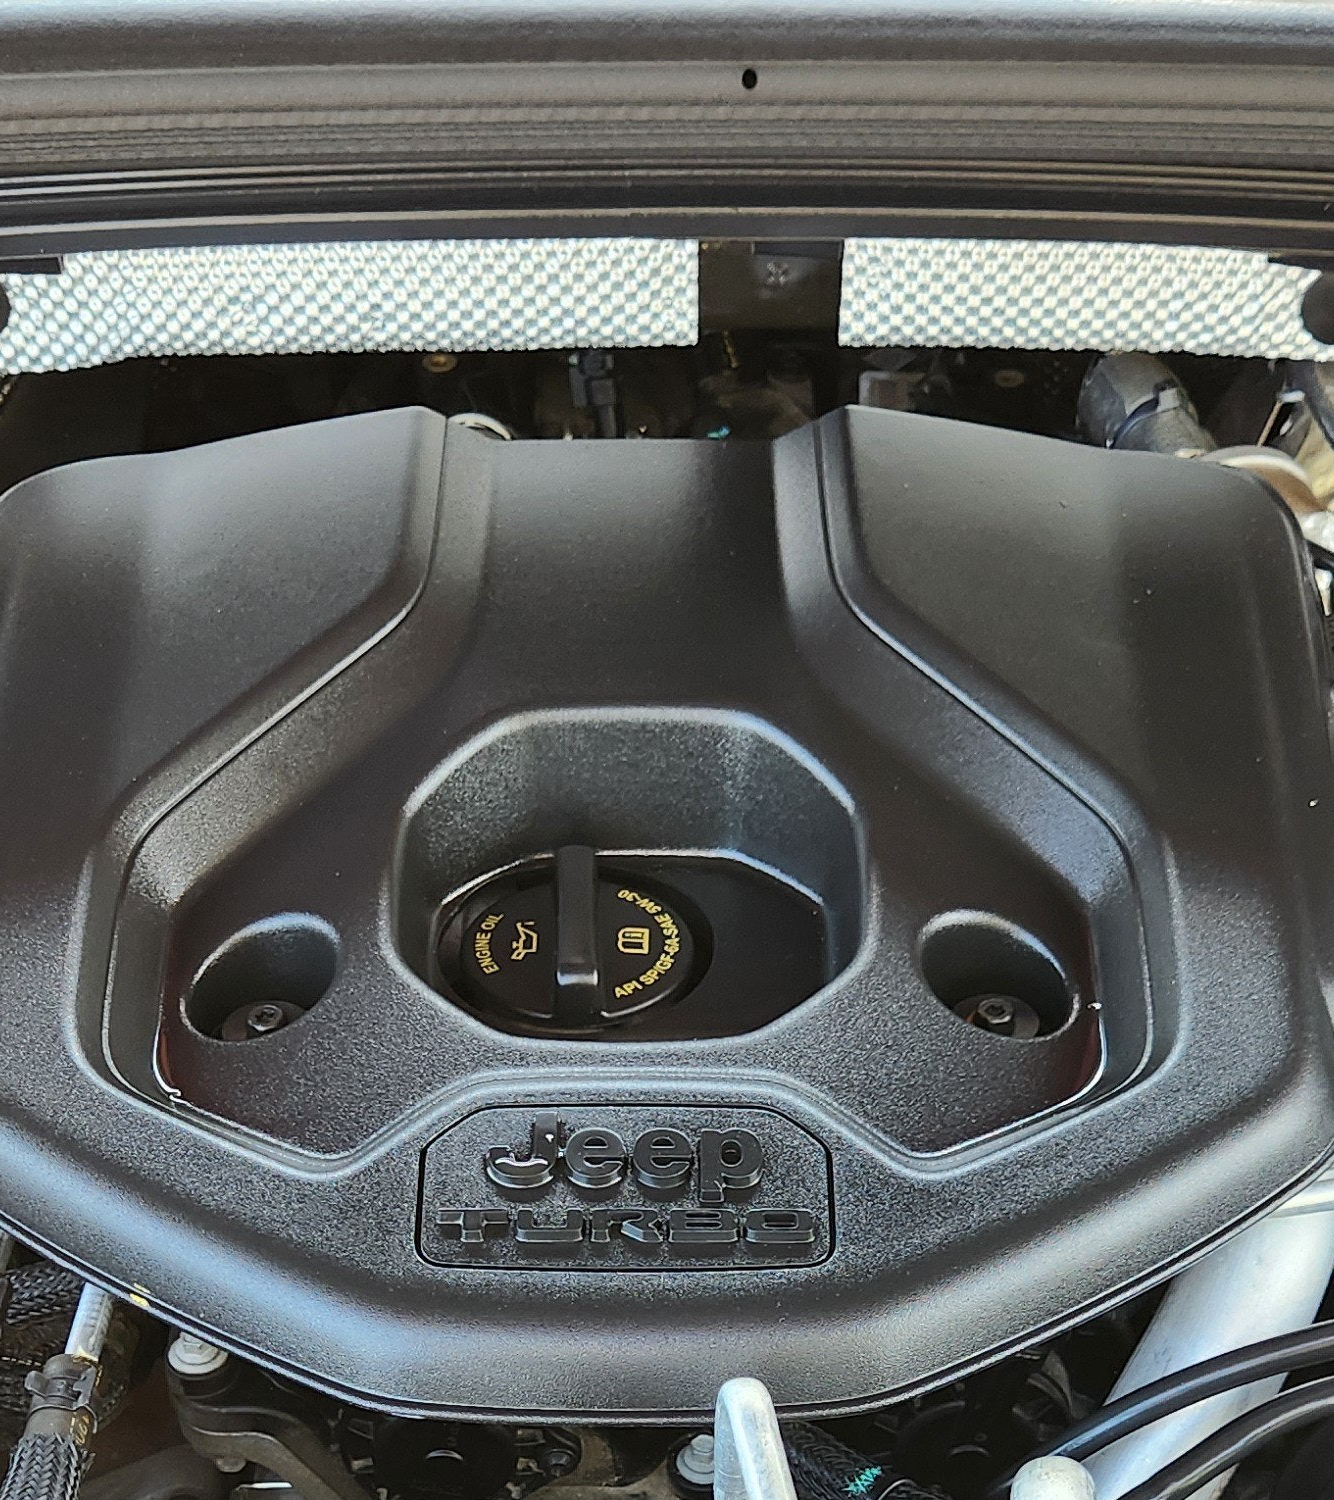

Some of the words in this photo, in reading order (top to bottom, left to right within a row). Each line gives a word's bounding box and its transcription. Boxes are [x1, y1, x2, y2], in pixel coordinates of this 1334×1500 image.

[617, 889, 662, 914] 5W-30
[480, 912, 504, 931] OIL
[654, 913, 679, 938] SAE
[473, 930, 499, 975] ENGINE
[614, 980, 643, 998] API
[485, 1110, 765, 1203] Jeep
[436, 1207, 816, 1243] TURBO
